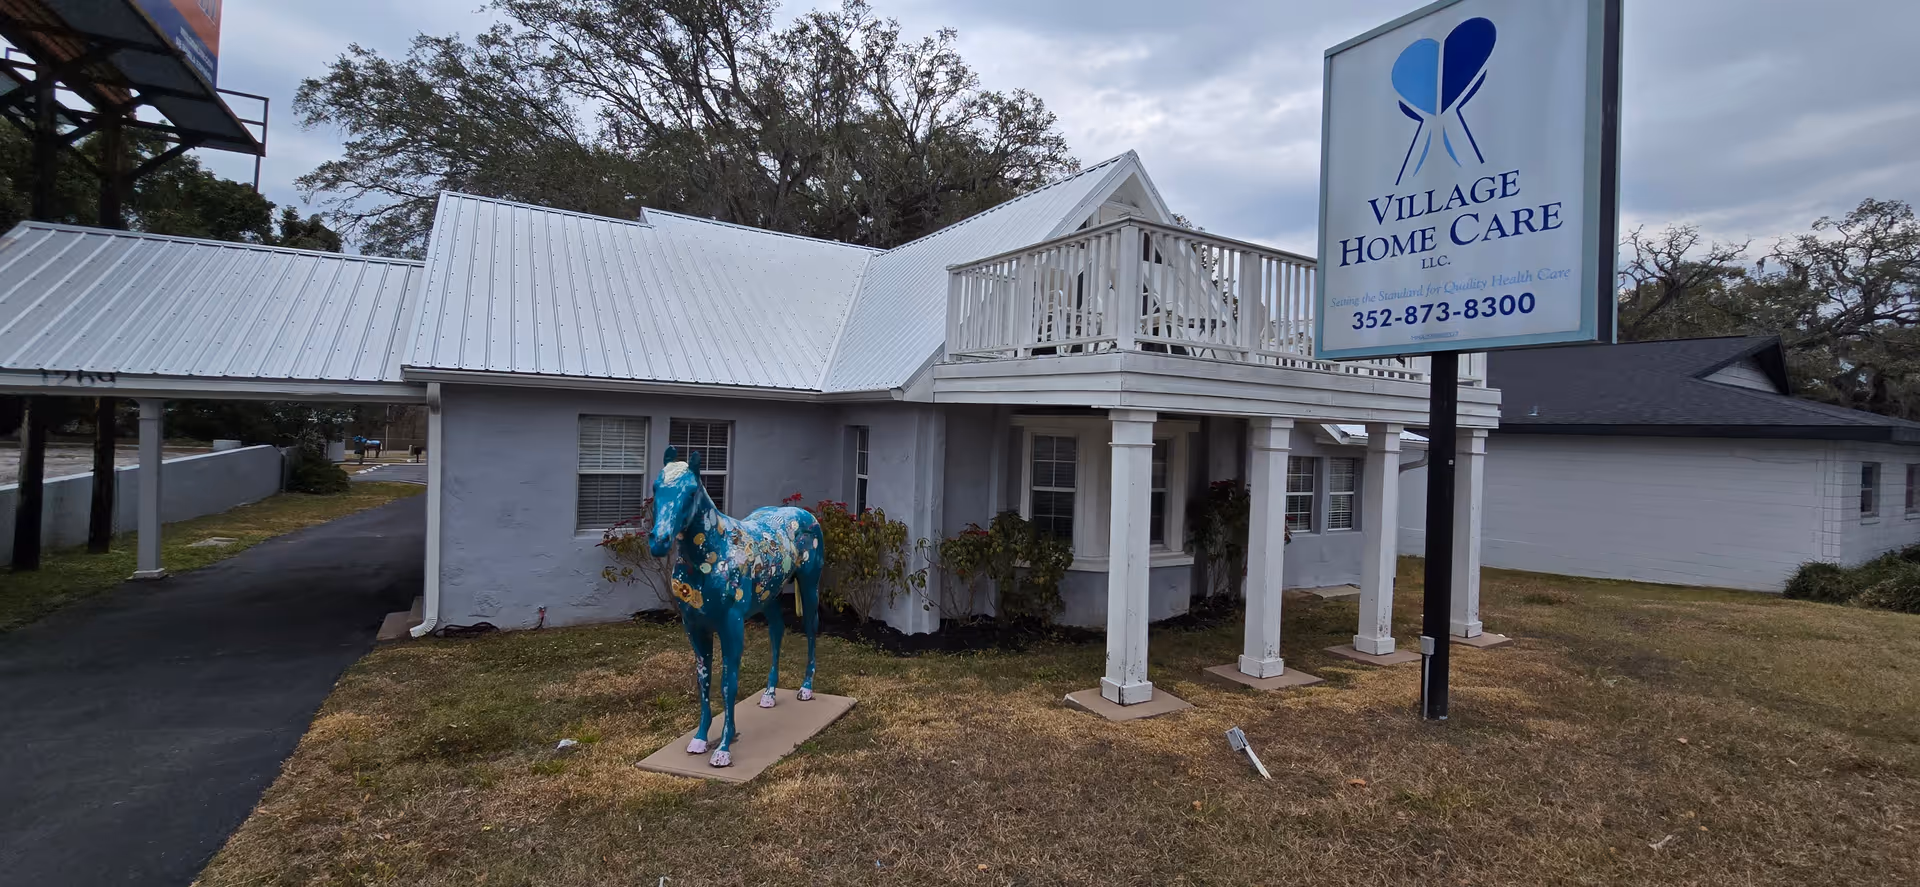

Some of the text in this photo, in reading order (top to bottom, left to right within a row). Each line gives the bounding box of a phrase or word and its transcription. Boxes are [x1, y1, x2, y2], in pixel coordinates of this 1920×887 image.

[1368, 169, 1521, 225] VILLAGE
[1339, 202, 1563, 267] HOME CARE
[1421, 255, 1451, 269] LLC.
[1330, 267, 1571, 308] Setting the Standard for Quality Health Care
[1352, 292, 1535, 330] 352-873-8300
